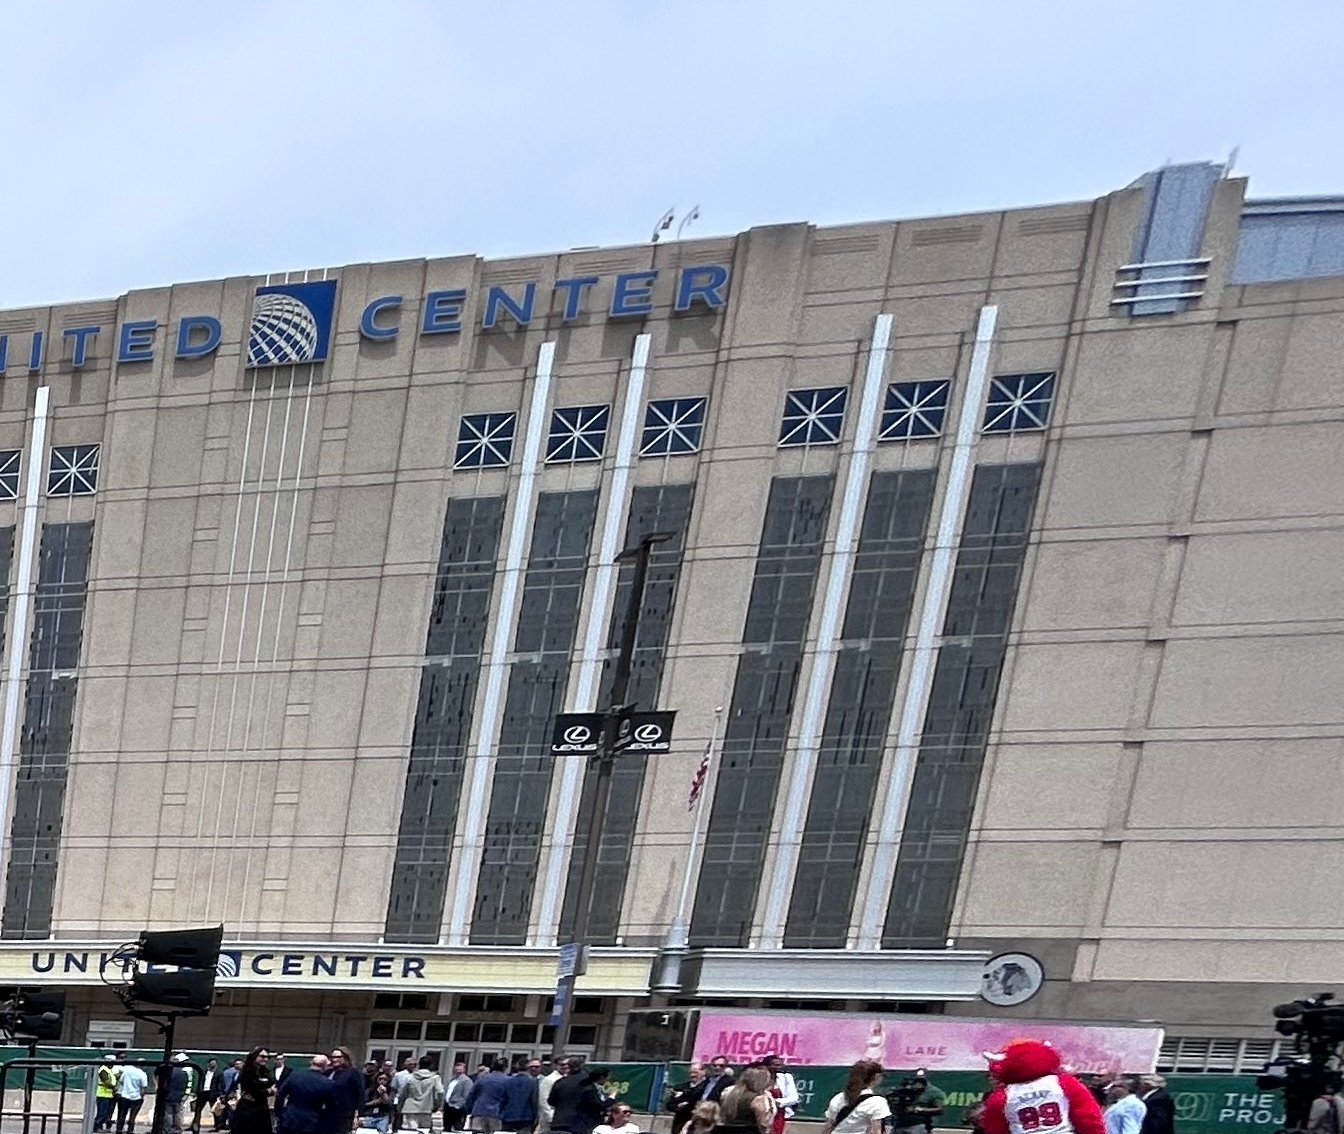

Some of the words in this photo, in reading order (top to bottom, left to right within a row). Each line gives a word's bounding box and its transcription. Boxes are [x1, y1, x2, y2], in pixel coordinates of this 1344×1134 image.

[360, 264, 729, 339] CENTER
[32, 952, 192, 976] UNIT
[250, 954, 426, 979] CENTER
[716, 1030, 798, 1056] MEGAN
[1223, 1092, 1276, 1109] THE
[1218, 1108, 1287, 1125] PROJ
